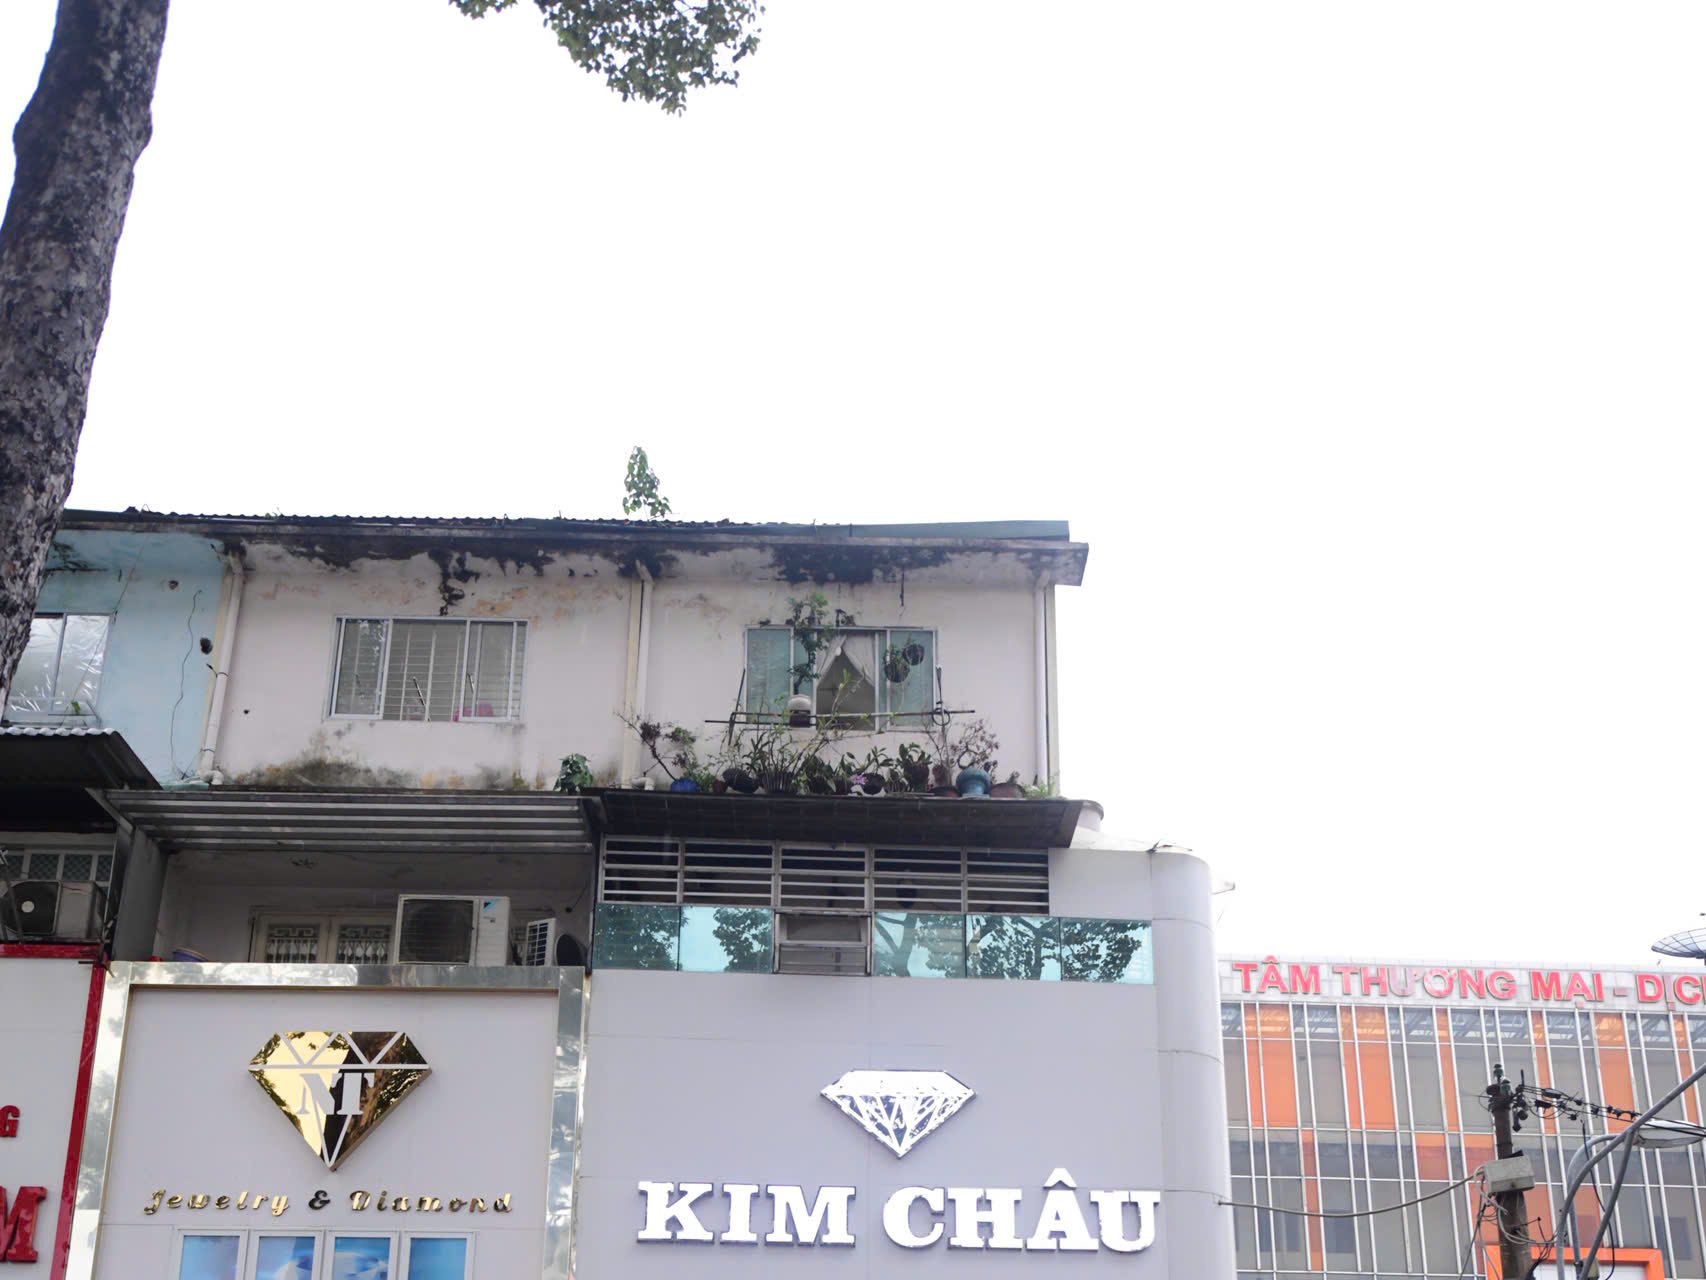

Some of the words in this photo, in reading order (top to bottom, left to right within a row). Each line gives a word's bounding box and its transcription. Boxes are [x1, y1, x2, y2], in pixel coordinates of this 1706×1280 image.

[1233, 955, 1321, 994] TÂM
[1333, 965, 1517, 999] THƯƠNG
[1530, 970, 1604, 1007] MẠI
[1636, 974, 1706, 1011] DỊC
[143, 1189, 289, 1217] Jewelry
[309, 1189, 331, 1210] &
[350, 1189, 513, 1212] Diamond
[637, 1181, 857, 1248] KIM
[883, 1168, 1161, 1252] CHÂU
